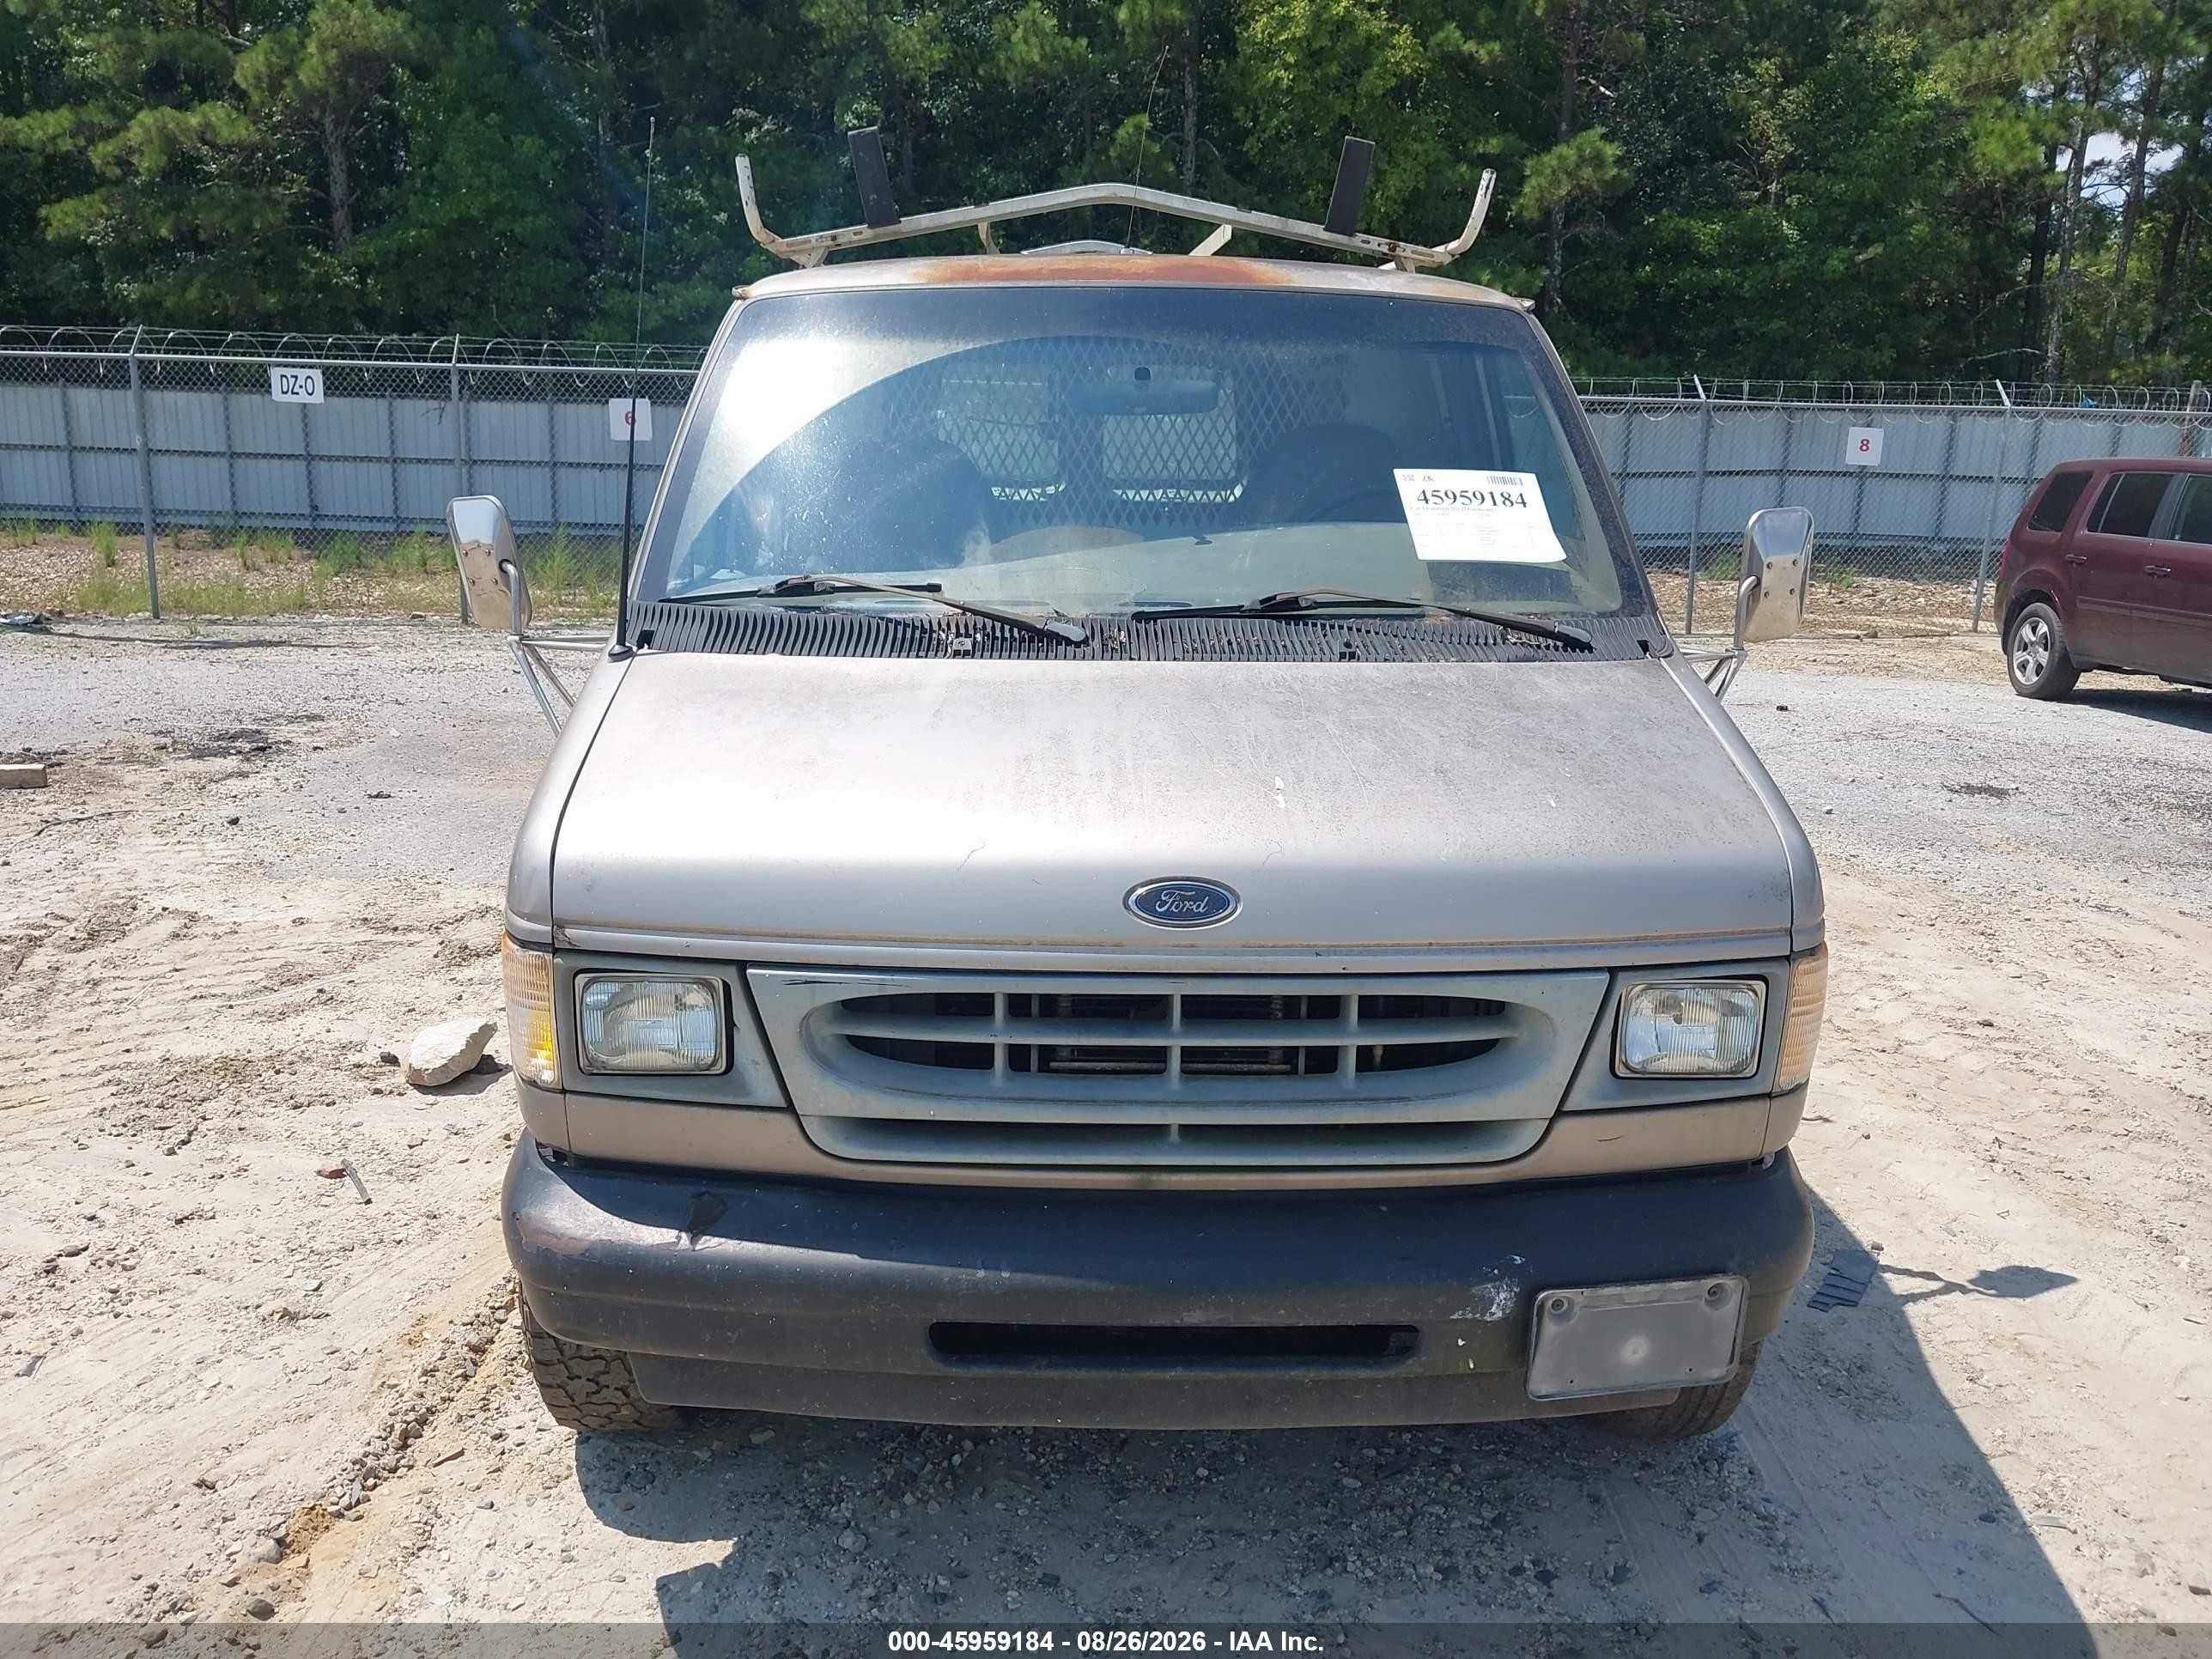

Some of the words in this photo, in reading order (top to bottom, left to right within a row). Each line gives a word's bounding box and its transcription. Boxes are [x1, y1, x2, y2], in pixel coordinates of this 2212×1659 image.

[1859, 438, 1870, 452] 8
[1417, 489, 1528, 508] 45959184
[1155, 890, 1209, 913] Ford
